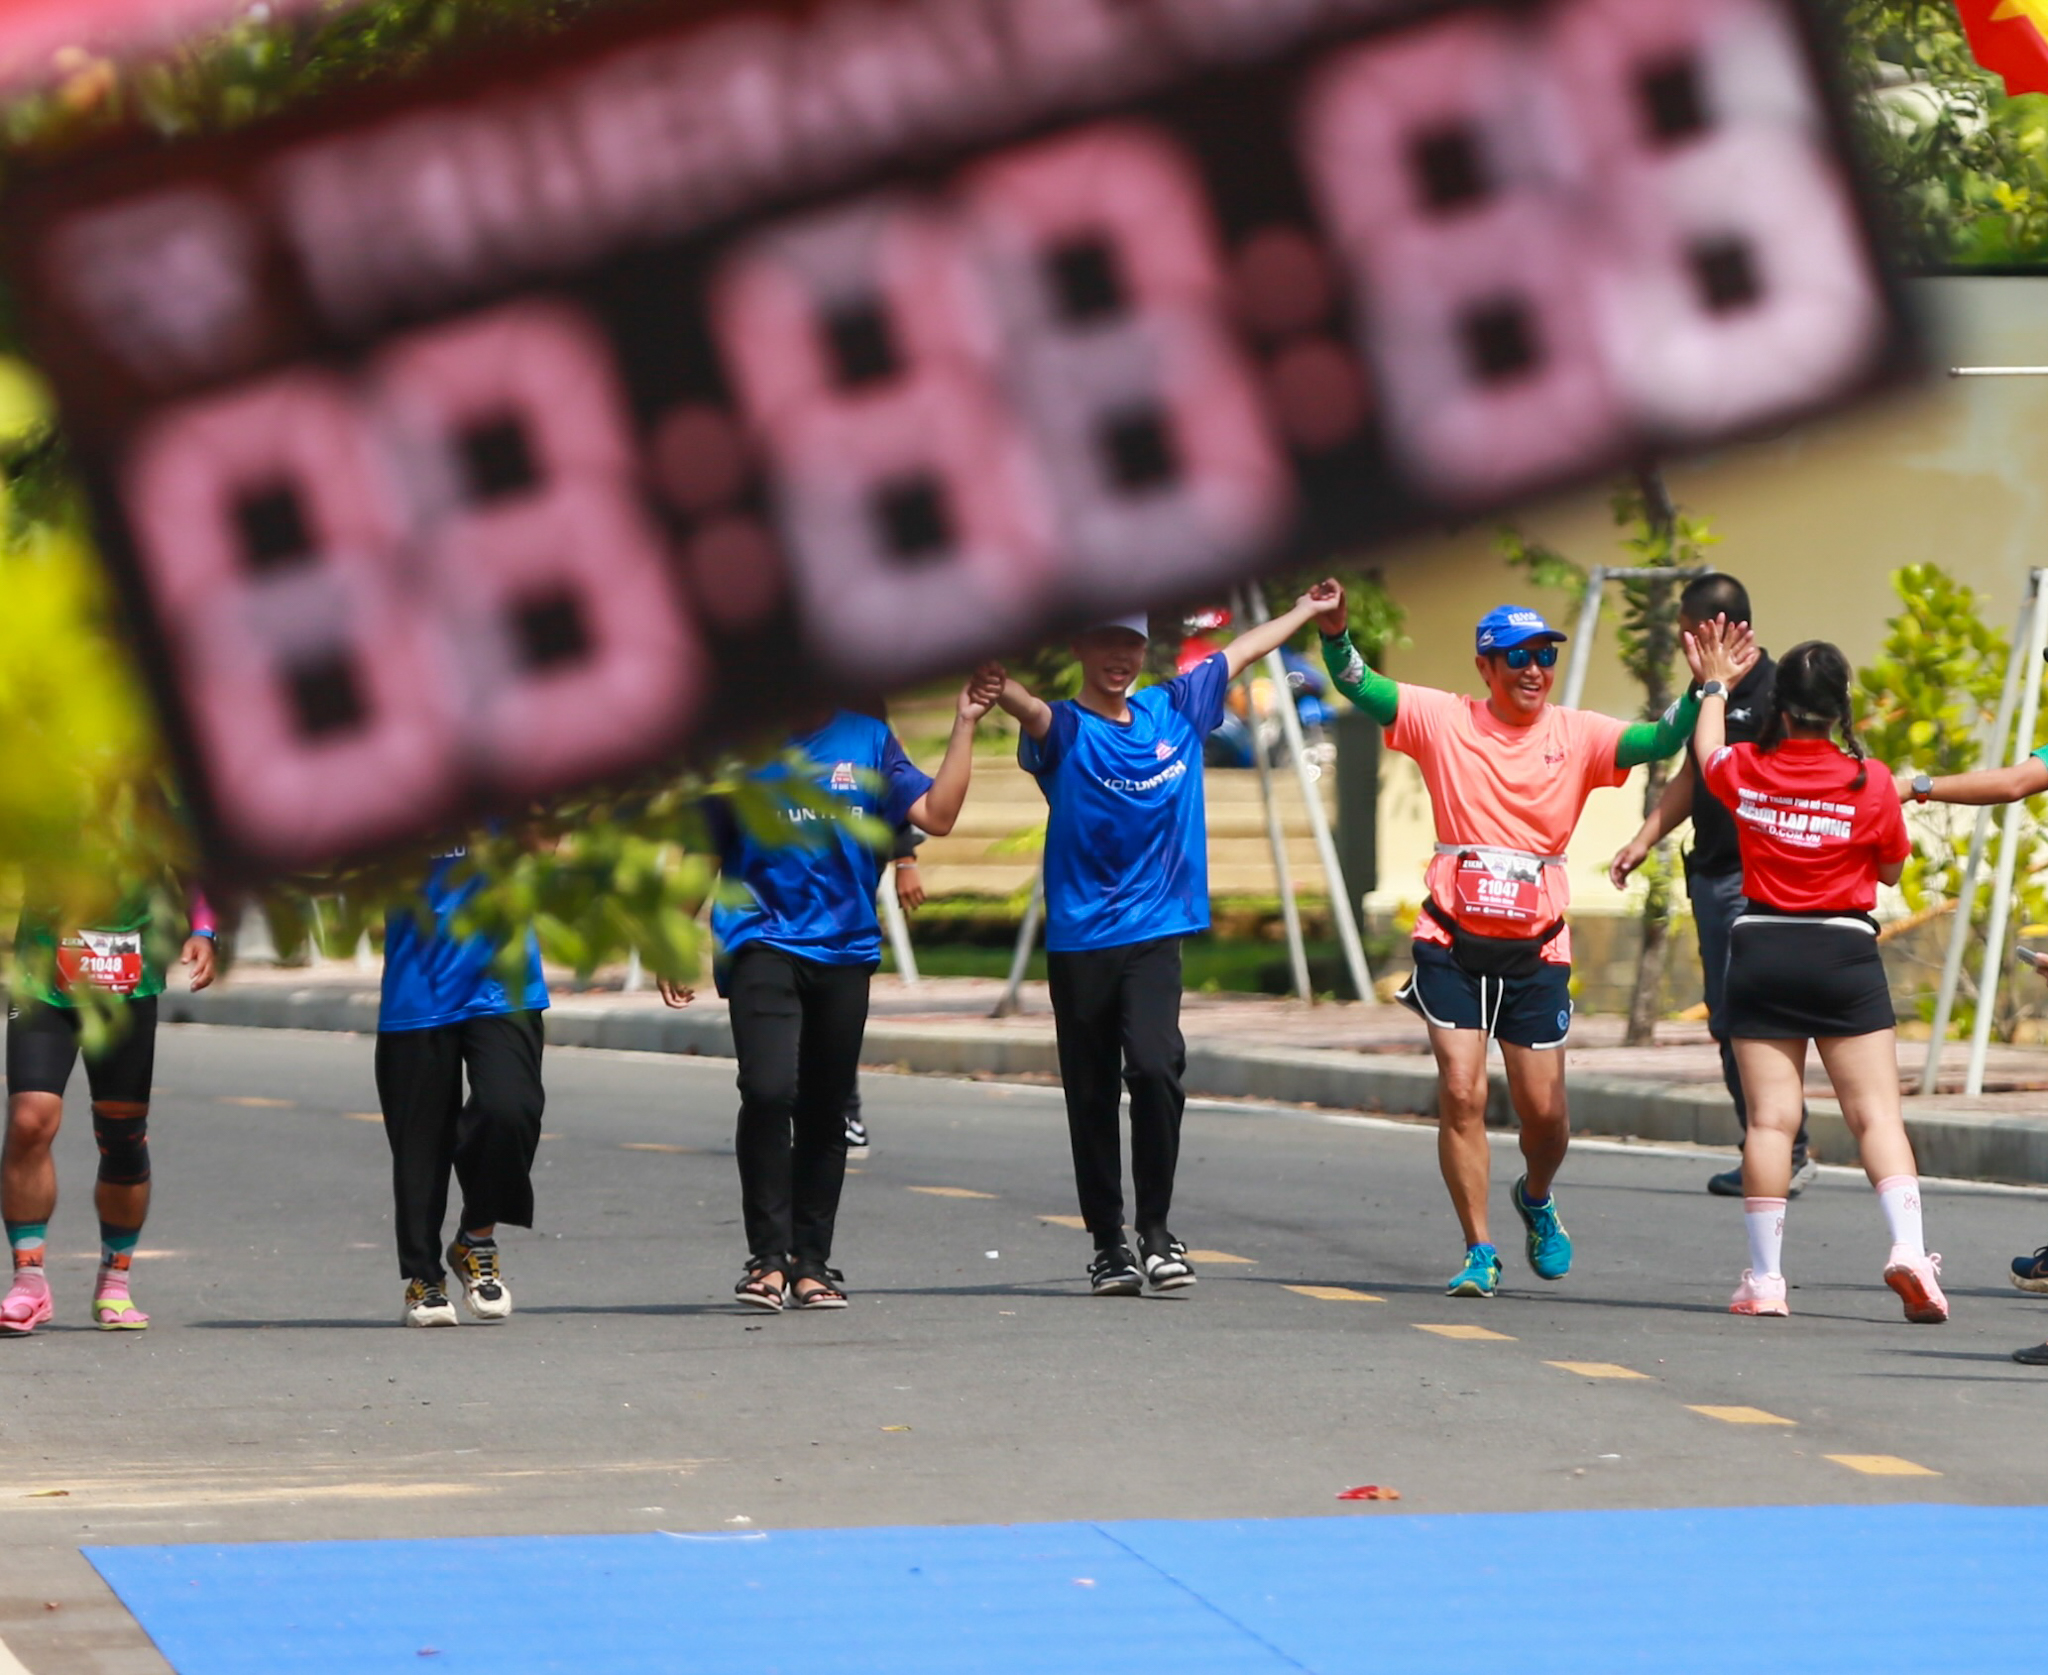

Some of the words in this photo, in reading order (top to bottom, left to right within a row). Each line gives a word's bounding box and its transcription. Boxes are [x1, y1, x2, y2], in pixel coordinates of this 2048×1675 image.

[1778, 811, 1808, 831] LAO
[1477, 878, 1519, 899] 21047
[79, 956, 123, 972] 21048
